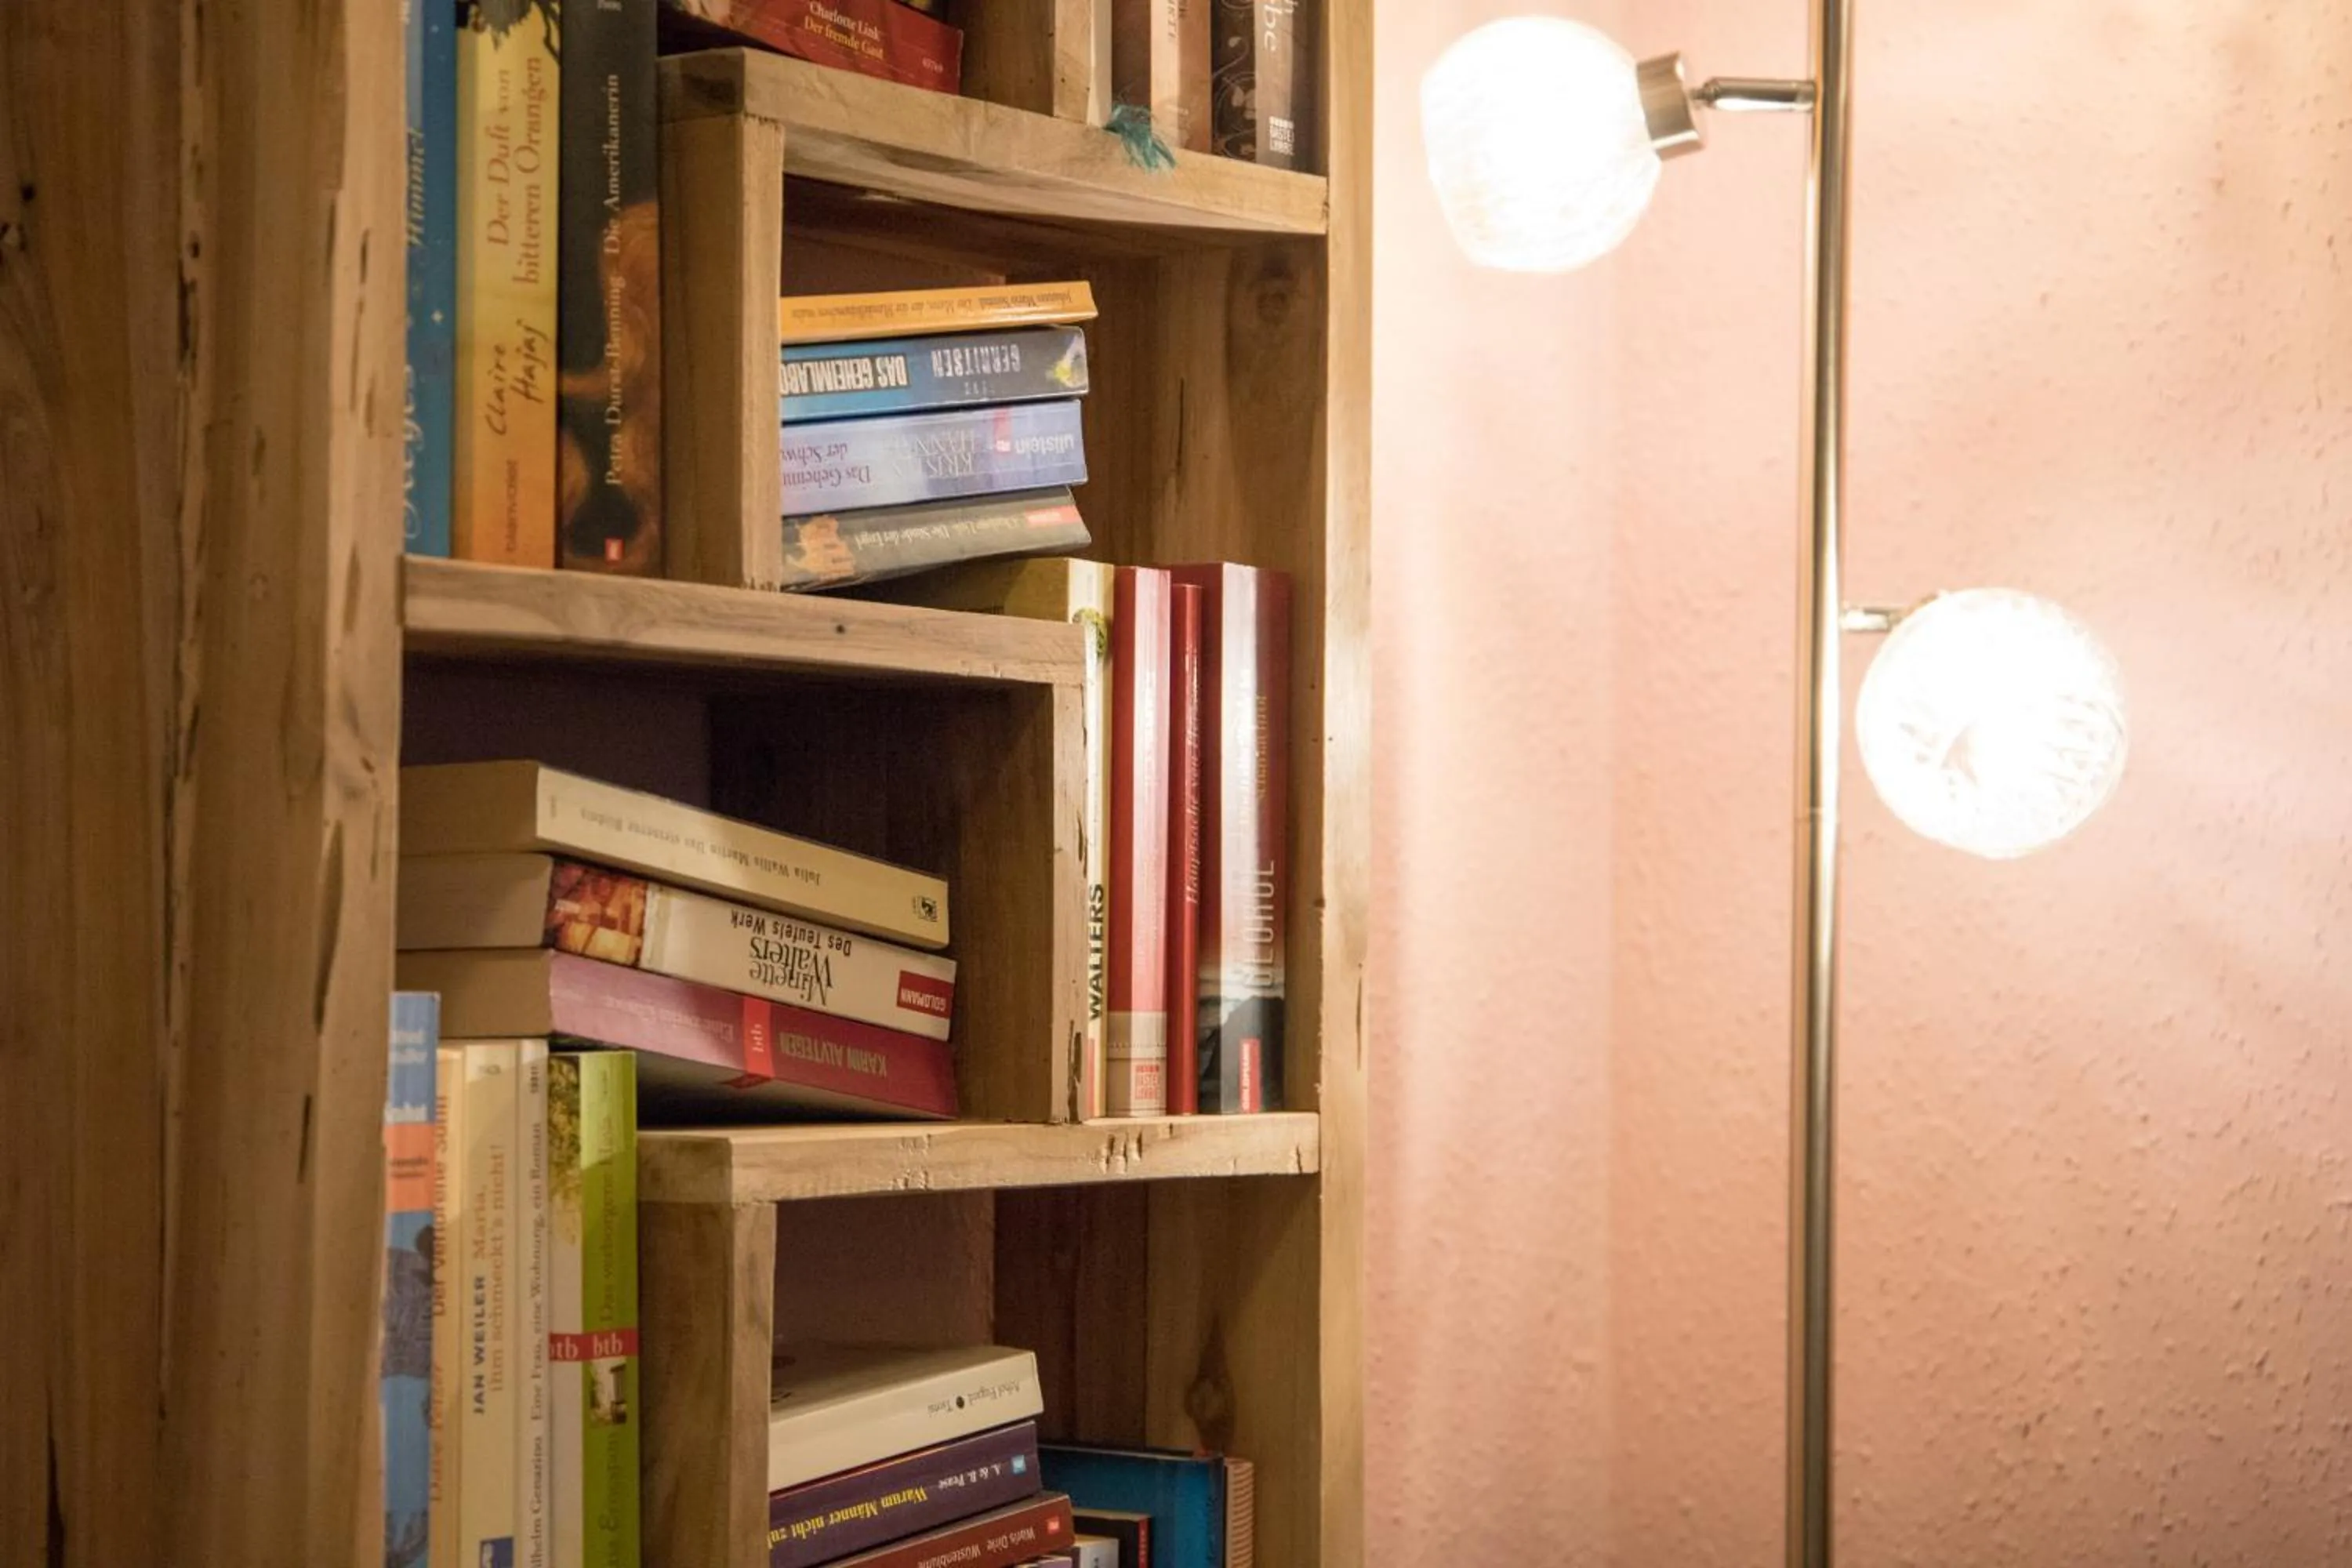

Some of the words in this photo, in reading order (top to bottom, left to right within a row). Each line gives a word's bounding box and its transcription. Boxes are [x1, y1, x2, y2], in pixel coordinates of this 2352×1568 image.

[804, 15, 823, 34] Der
[858, 20, 880, 42] Link
[514, 56, 548, 174] Orangen
[485, 124, 510, 185] Duft
[602, 74, 622, 211] Amerikanerin
[487, 195, 510, 246] Der
[513, 183, 541, 285] bitteren
[603, 216, 620, 255] Die
[510, 318, 551, 405] Hajaj
[604, 274, 626, 425] Durst-Benning
[931, 343, 1021, 379] GERRITSEN
[875, 354, 909, 388] DAS
[485, 343, 507, 436] Claire
[605, 433, 623, 485] Petra
[826, 442, 848, 460] der
[1016, 433, 1075, 456] ullstein
[846, 466, 871, 485] Das
[710, 845, 750, 866] Martin
[753, 855, 789, 878] Wallis
[793, 866, 821, 886] Julia
[731, 909, 766, 936] Werk
[772, 920, 822, 949] Teufels
[750, 937, 833, 988] Walters
[827, 937, 852, 956] Des
[1088, 883, 1104, 1022] WALTERS
[749, 960, 829, 1007] Minette
[901, 988, 946, 1012] GOLDMANN
[779, 1031, 843, 1069] ALVTEGEN
[847, 1046, 888, 1079] KARIN
[532, 1122, 542, 1180] Roman
[490, 1143, 504, 1210] nicht!
[474, 1276, 485, 1367] WEILER
[592, 1332, 623, 1357] btb
[489, 1350, 504, 1393] ihm
[474, 1374, 485, 1416] JAN
[531, 1383, 542, 1421] Eine
[938, 1472, 965, 1490] Pease
[967, 1469, 978, 1483] B.
[980, 1466, 990, 1479] &
[993, 1463, 1002, 1475] A.
[829, 1497, 878, 1526] Männer
[881, 1485, 928, 1509] Warum
[529, 1516, 542, 1568] ilhelm
[791, 1515, 825, 1540] nicht
[1009, 1527, 1036, 1546] Waris
